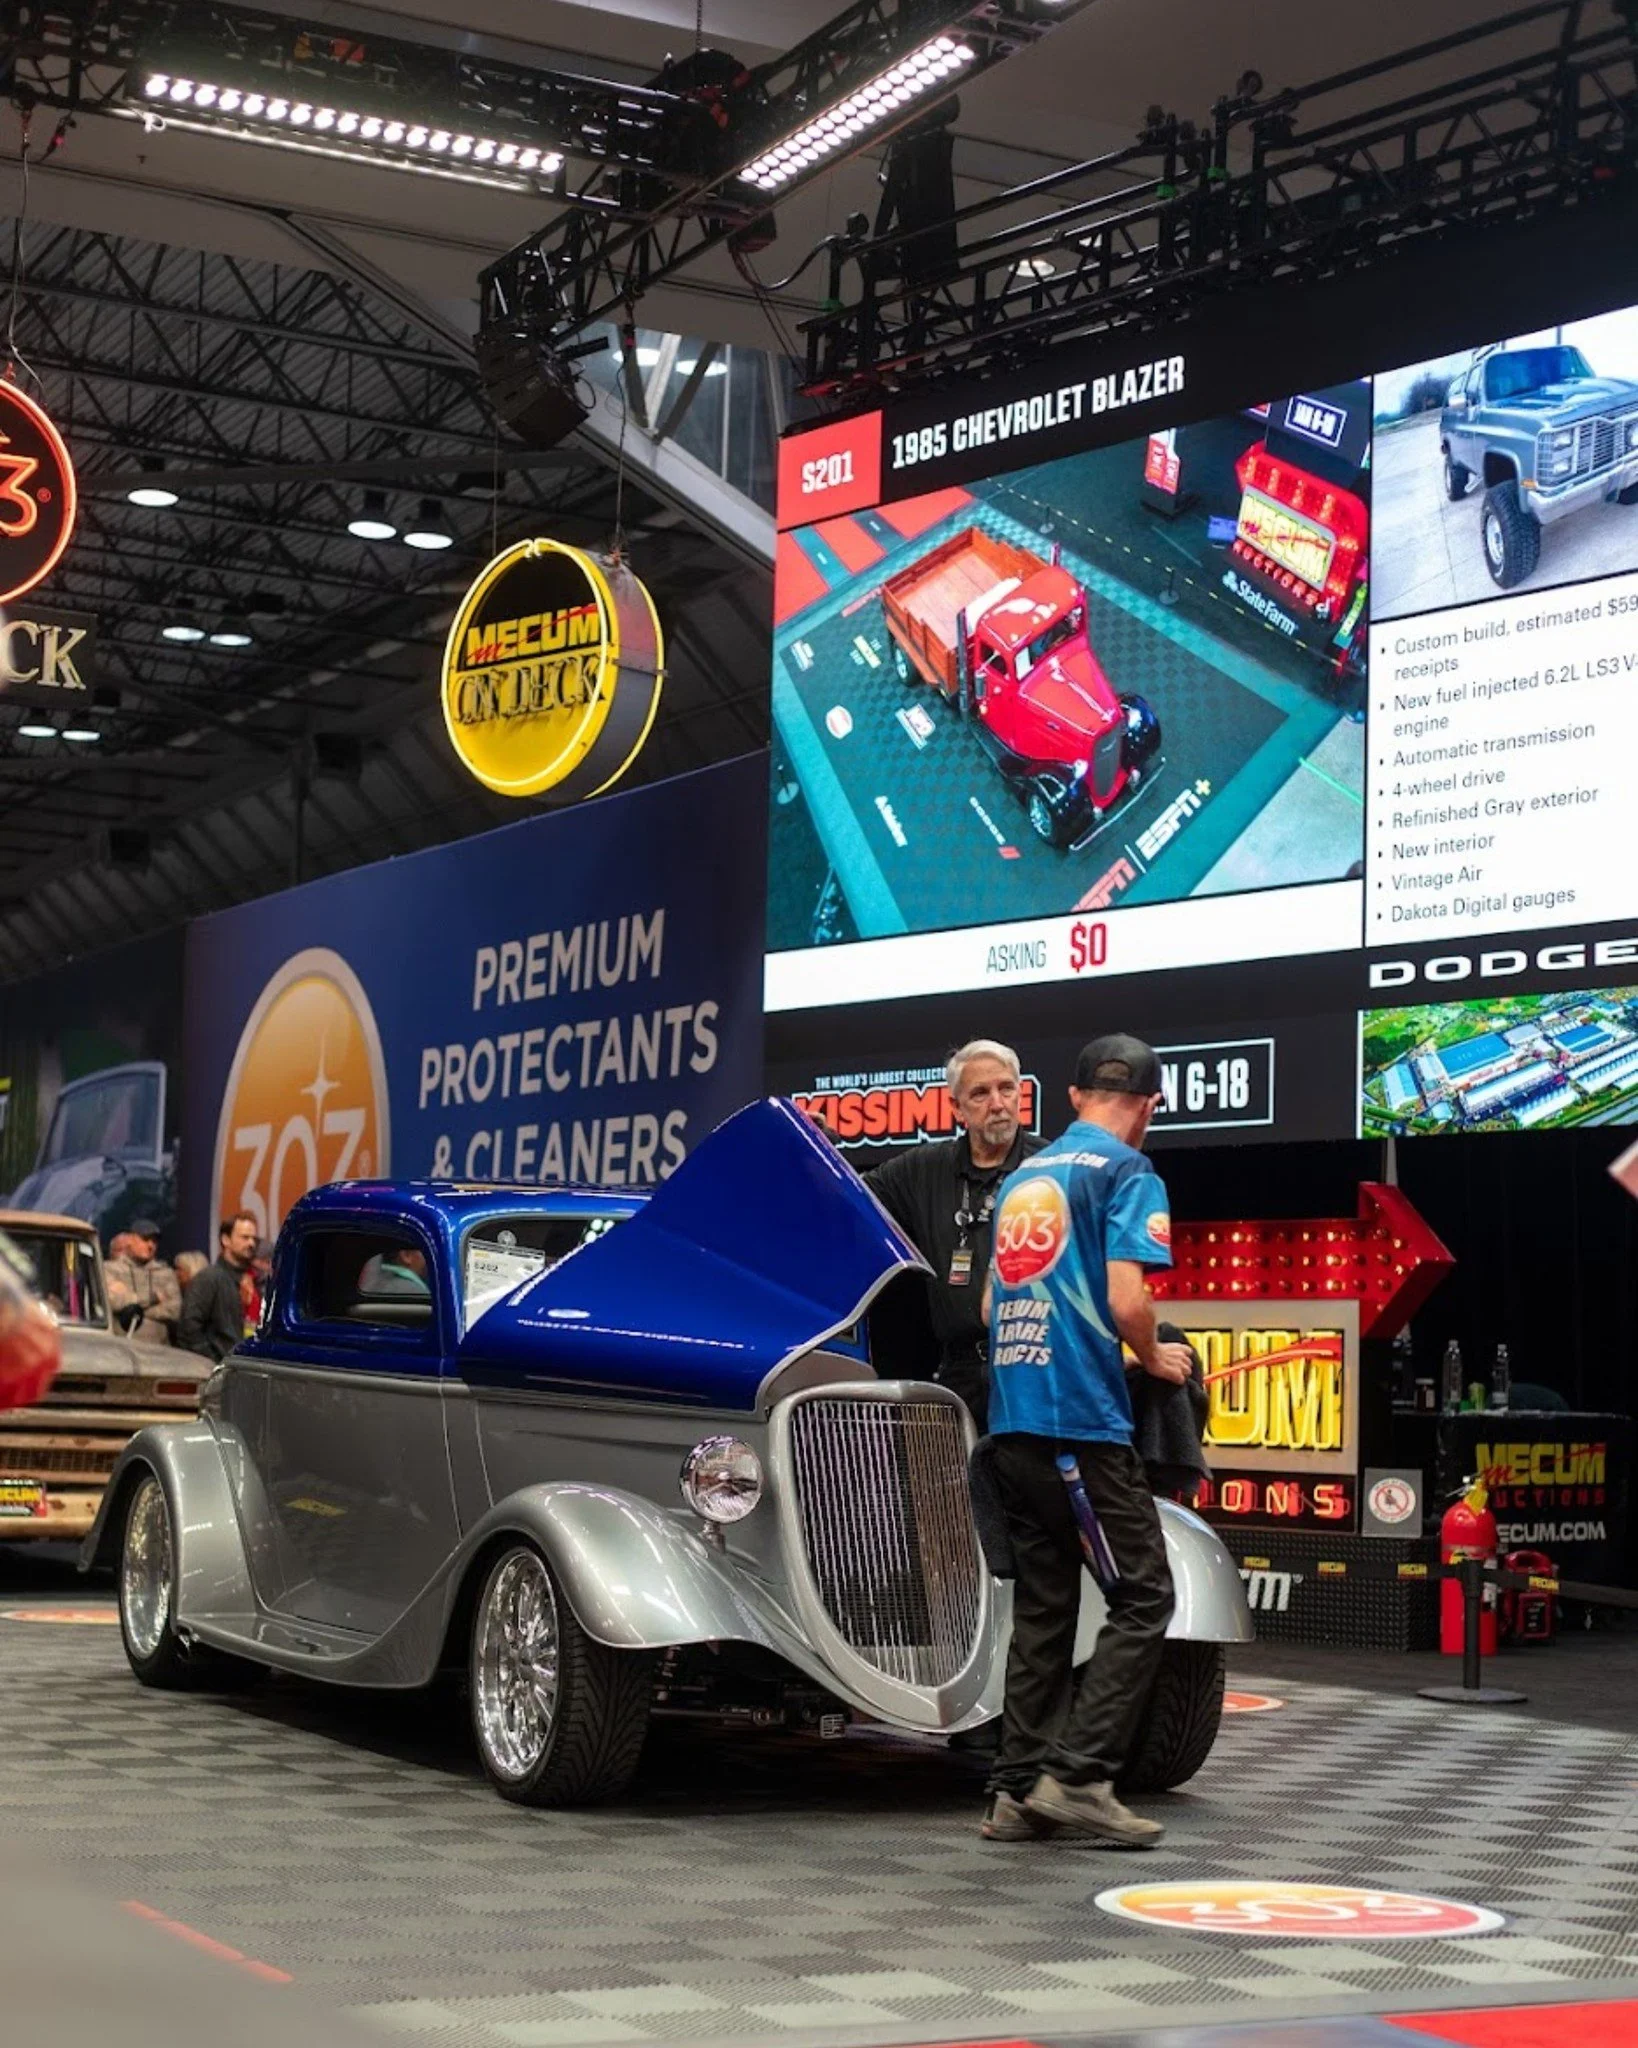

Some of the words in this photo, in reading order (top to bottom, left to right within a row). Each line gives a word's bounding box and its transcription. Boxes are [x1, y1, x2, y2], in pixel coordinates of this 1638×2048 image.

[892, 427, 947, 470] 1985
[952, 386, 1085, 451] CHEVROLET
[1092, 354, 1185, 414] BLAZER
[801, 449, 855, 495] S201
[466, 603, 602, 667] MECUM
[1394, 634, 1459, 655] Custom
[1516, 601, 1602, 633] estimated
[1393, 694, 1432, 712] New
[1436, 683, 1467, 705] fuel
[1472, 671, 1539, 700] injected
[1544, 664, 1581, 686] 6.2L
[1586, 656, 1620, 679] LS3
[1394, 657, 1459, 681] receipts
[1392, 740, 1479, 767] Automatic
[1483, 724, 1596, 752] transmission
[1393, 715, 1449, 738] engine
[1392, 773, 1457, 798] 4-wheel
[1462, 768, 1506, 788] drive
[1392, 802, 1479, 829] Refinished
[1485, 798, 1525, 817] Gray
[1530, 786, 1599, 811] exterior
[1392, 842, 1430, 860] New
[1434, 833, 1496, 855] interior
[1391, 870, 1454, 891] Vintage
[1457, 865, 1483, 883] Air
[1391, 901, 1448, 923] Dakota
[1453, 893, 1508, 918] Digital
[1513, 888, 1577, 912] gauges
[473, 907, 666, 1012] PREMIUM
[985, 940, 1048, 974] ASKING
[1069, 921, 1107, 974] $0
[1369, 937, 1638, 989] DODGE
[418, 1000, 720, 1110] PROTECTANTS
[815, 1077, 831, 1090] THE
[832, 1072, 867, 1088] WORLD'S
[869, 1070, 905, 1085] LARGEST
[1186, 1058, 1249, 1111] 6-18
[465, 1109, 689, 1186] CLEANERS
[997, 1211, 1057, 1255] 303
[1188, 1329, 1343, 1451] UM
[1475, 1442, 1606, 1486] MECUM
[1495, 1487, 1605, 1509] UCTIONS
[1496, 1520, 1607, 1544] ECUM.COM
